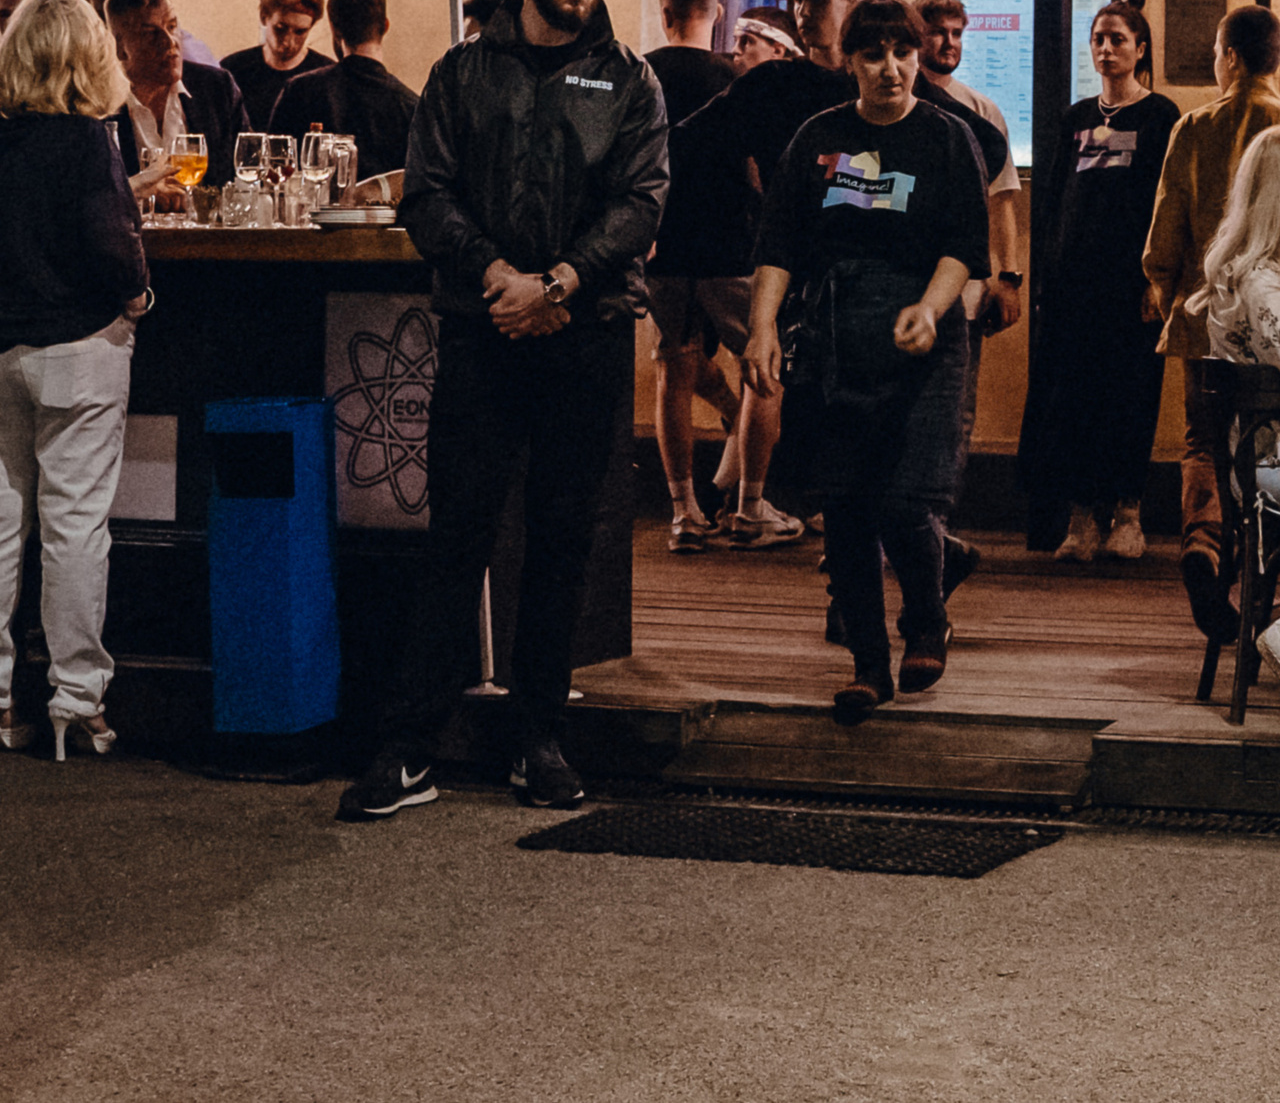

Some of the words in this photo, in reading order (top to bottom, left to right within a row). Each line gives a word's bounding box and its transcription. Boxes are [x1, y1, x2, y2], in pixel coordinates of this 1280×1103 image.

[985, 17, 1012, 29] PRICE
[565, 75, 579, 85] NO
[580, 78, 614, 91] STRESS
[836, 174, 890, 192] Imagine!
